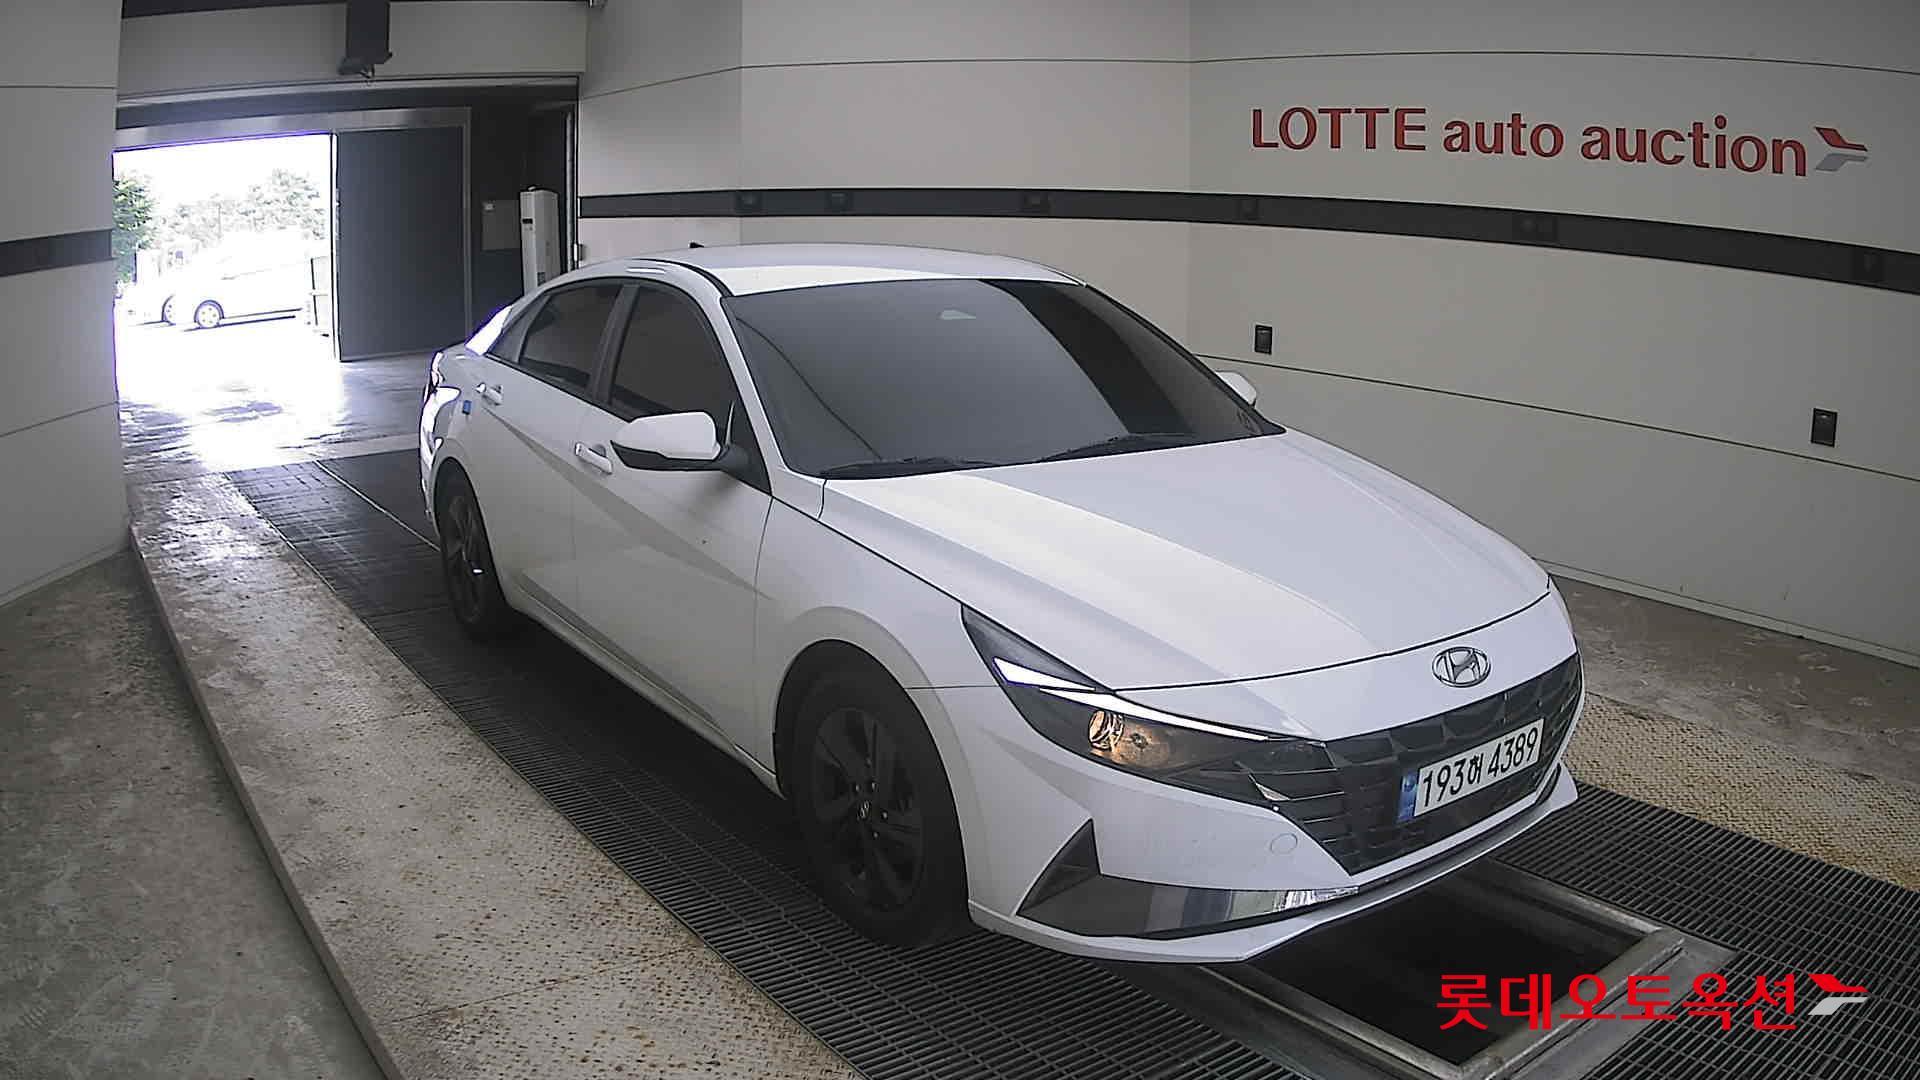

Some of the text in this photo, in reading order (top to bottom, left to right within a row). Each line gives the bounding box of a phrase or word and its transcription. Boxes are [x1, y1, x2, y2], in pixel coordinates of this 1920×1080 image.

[1252, 108, 1807, 177] LOTTE auto auction
[1423, 727, 1539, 807] 193허 4389
